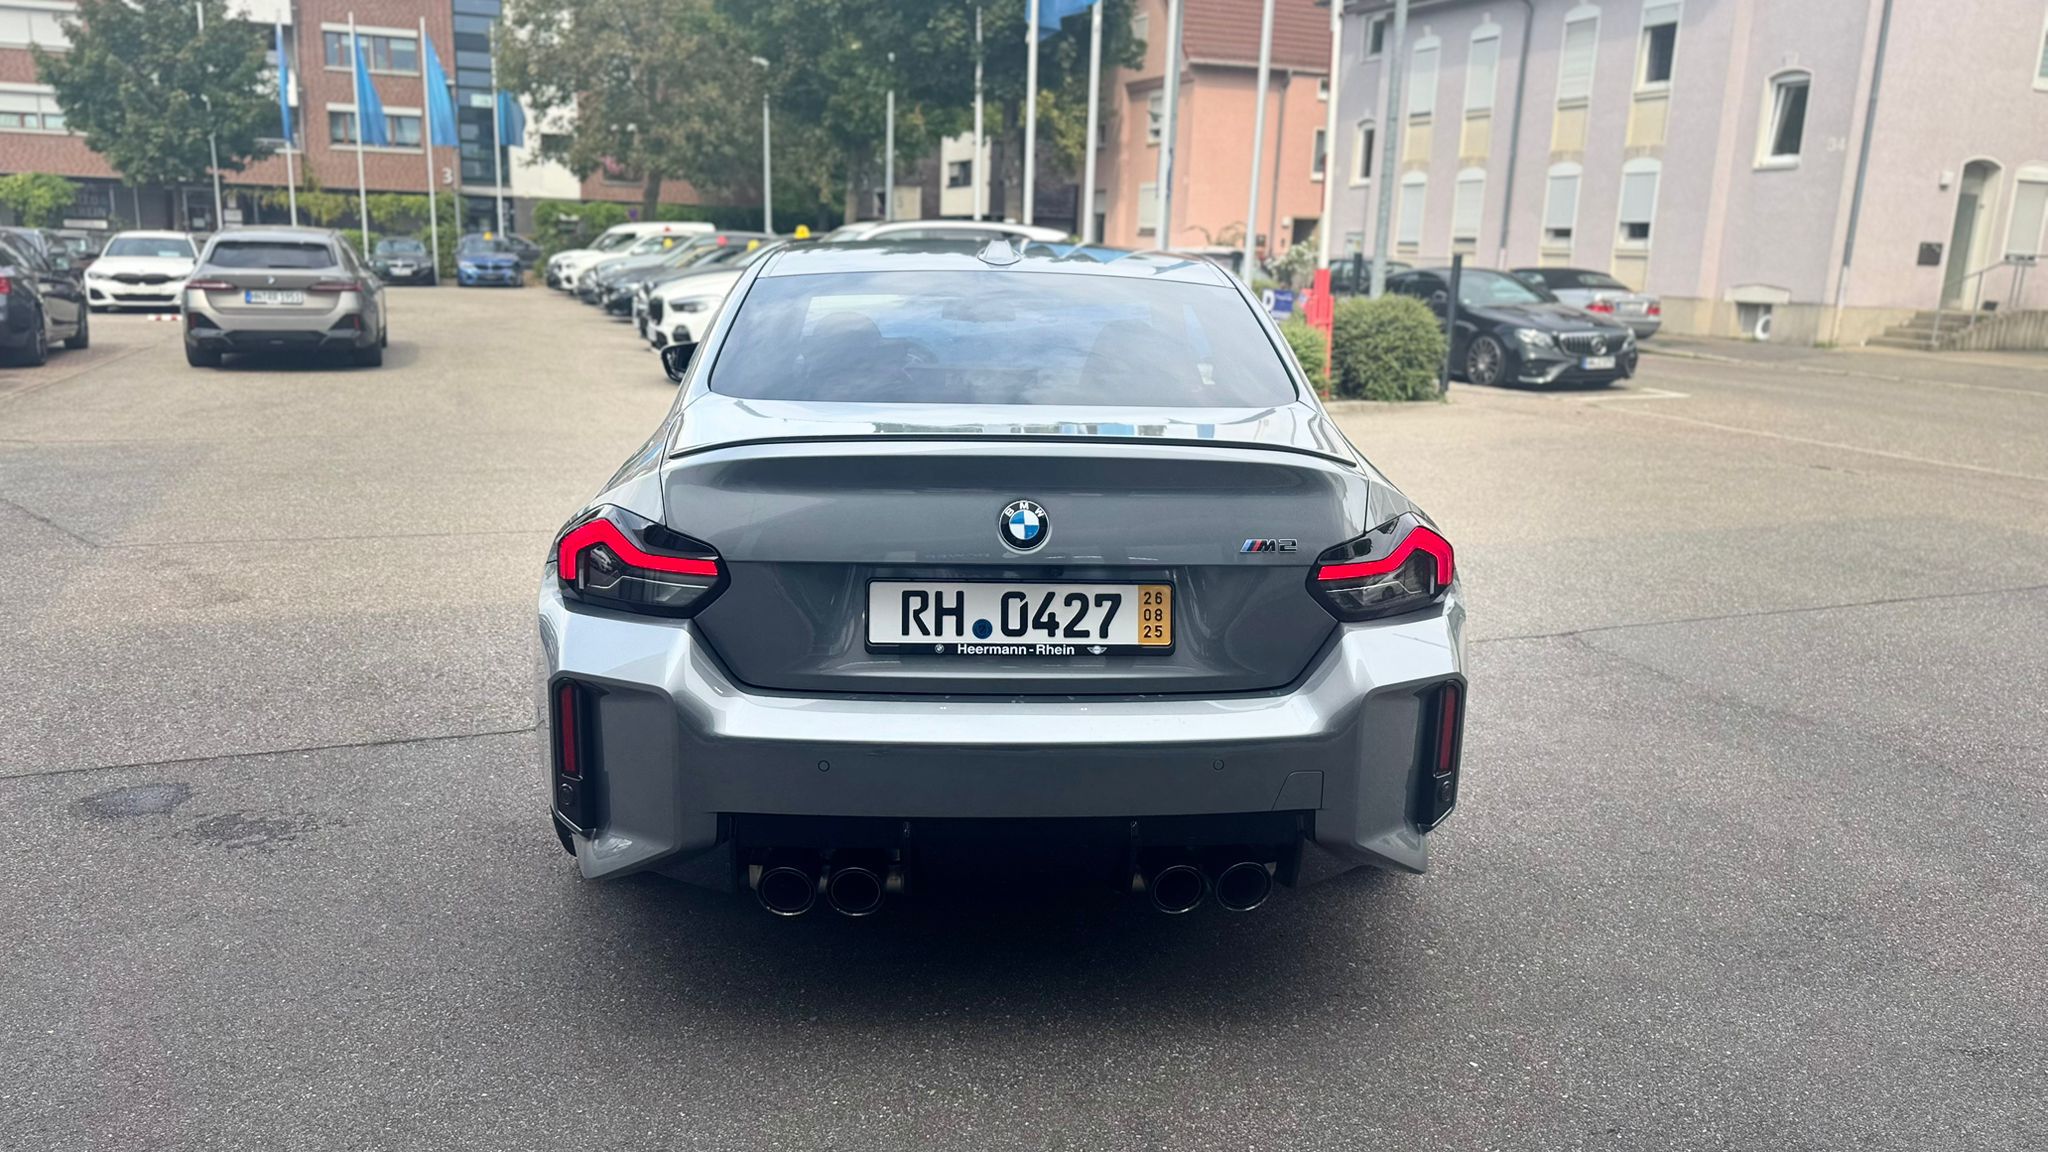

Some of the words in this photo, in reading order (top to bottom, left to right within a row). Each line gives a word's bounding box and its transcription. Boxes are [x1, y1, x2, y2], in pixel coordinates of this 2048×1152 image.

[442, 167, 453, 185] 3
[1004, 501, 1045, 518] BMW
[1143, 591, 1163, 605] 26
[901, 590, 964, 637] RH
[1000, 591, 1122, 639] 0427
[1143, 608, 1163, 622] 08
[1143, 625, 1163, 638] 25
